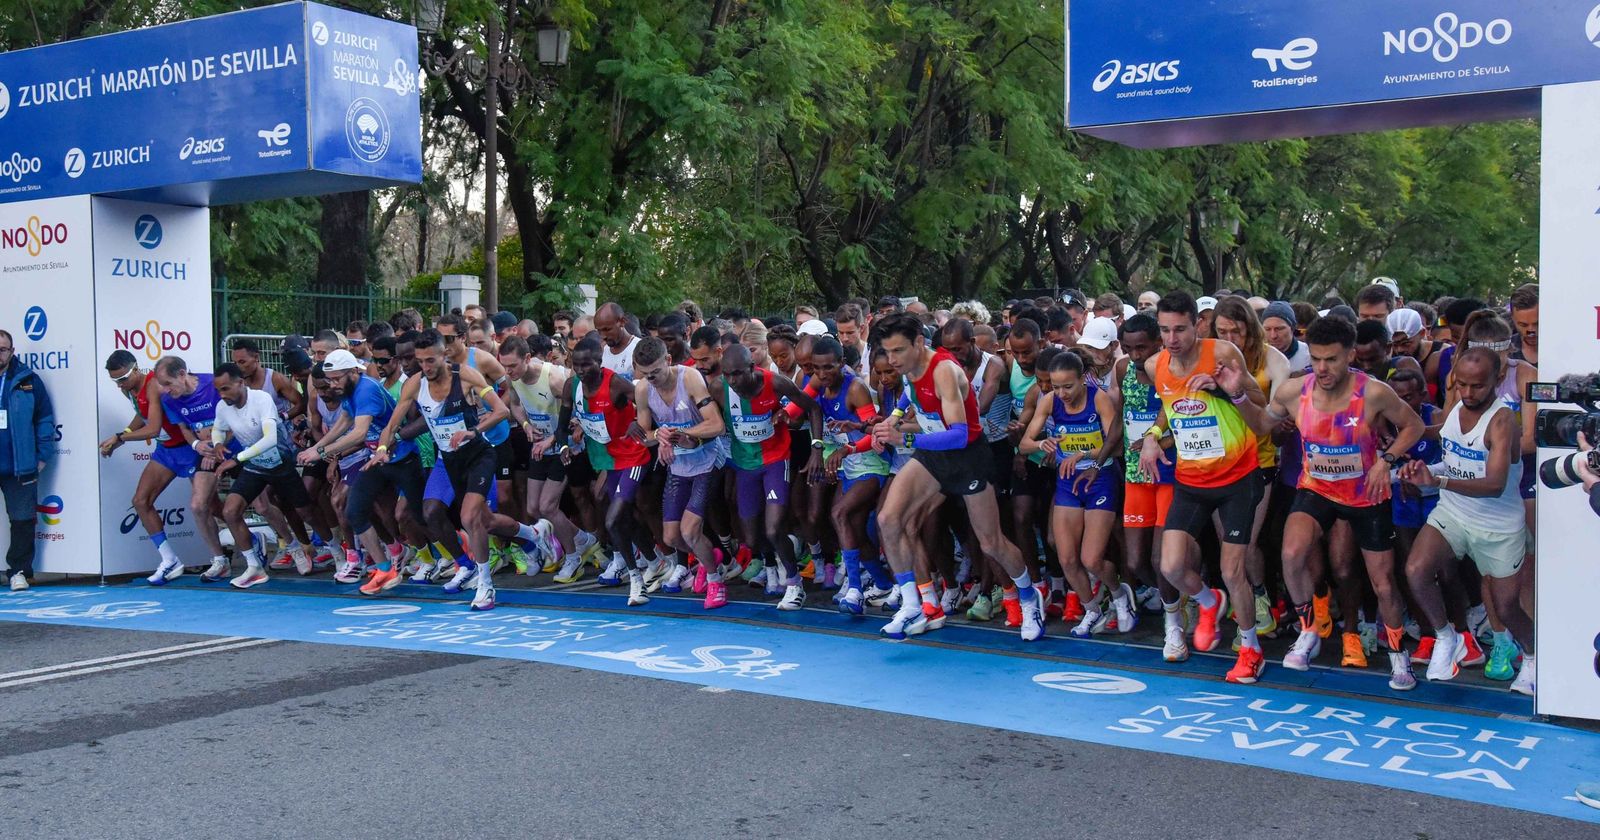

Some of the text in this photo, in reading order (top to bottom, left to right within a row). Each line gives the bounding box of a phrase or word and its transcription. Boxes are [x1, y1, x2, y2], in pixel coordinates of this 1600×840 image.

[334, 31, 378, 51] ZURICH
[333, 50, 379, 70] MARATÓN
[18, 43, 298, 108] ZURICH MARATÓN DE SEVILLA
[333, 66, 381, 87] SEVILLA
[1252, 74, 1318, 89] TotalEnergies
[1458, 68, 1471, 78] DE
[1116, 90, 1136, 99] sound
[1154, 86, 1174, 95] sound
[1175, 84, 1193, 94] body
[92, 145, 150, 169] ZURICH
[112, 258, 186, 280] ZURICH
[17, 351, 69, 370] URICH
[190, 402, 213, 413] ZURICH
[1185, 419, 1211, 427] ZURICH
[742, 429, 767, 437] PACER
[1066, 443, 1096, 451] FATIMA
[1184, 440, 1212, 450] PACER
[1314, 464, 1356, 473] KHADIRI
[423, 610, 650, 631] ZURICH
[315, 626, 558, 652] SEVILLA
[1176, 691, 1544, 750] ZURICH
[1105, 717, 1516, 791] SEVILLA
